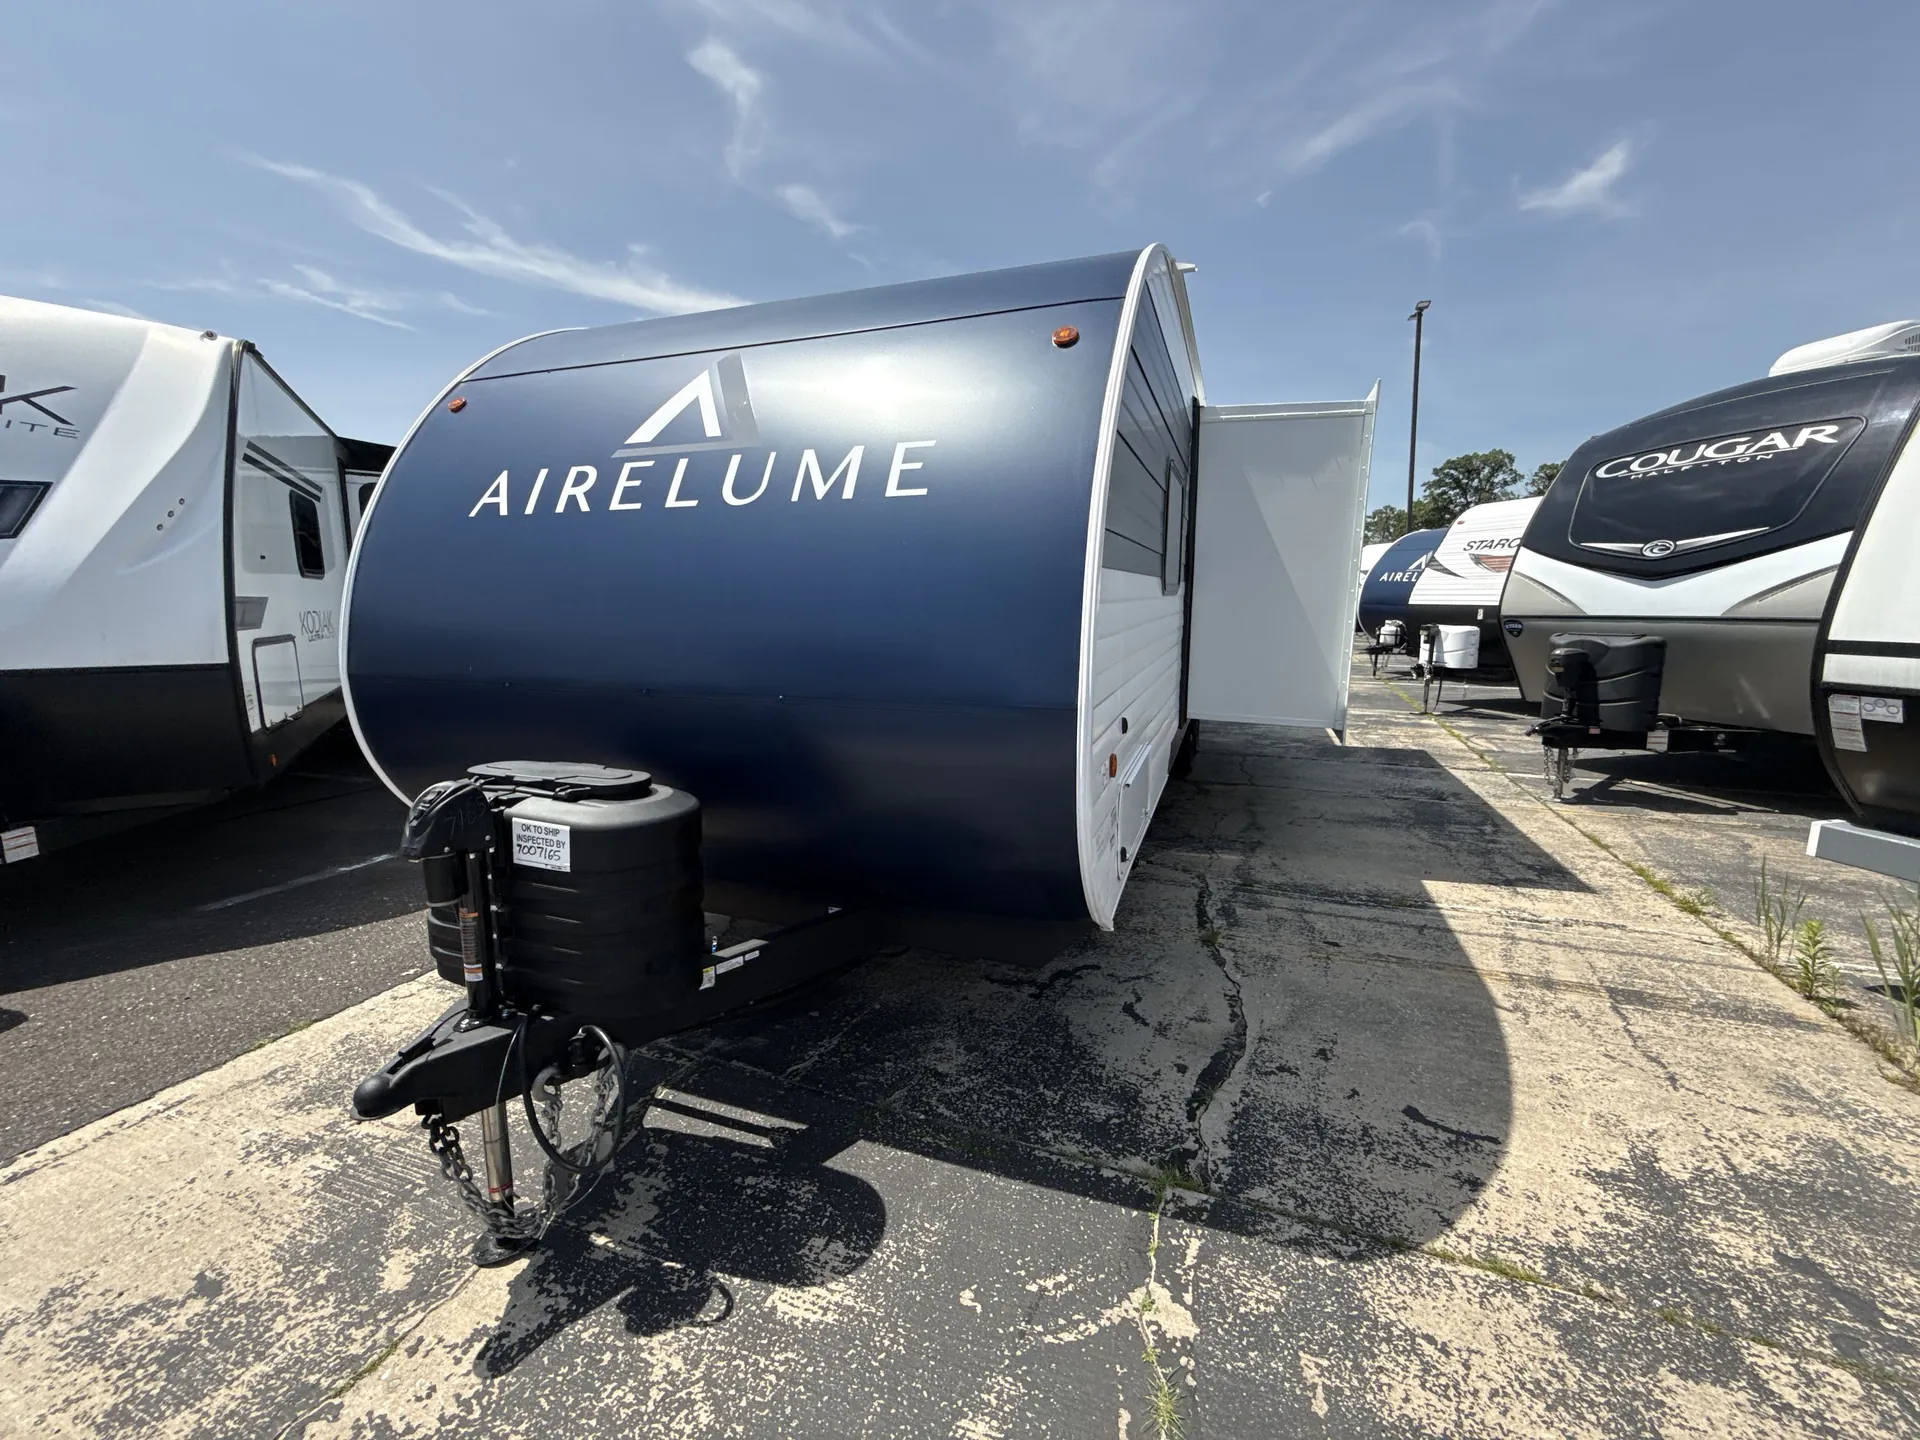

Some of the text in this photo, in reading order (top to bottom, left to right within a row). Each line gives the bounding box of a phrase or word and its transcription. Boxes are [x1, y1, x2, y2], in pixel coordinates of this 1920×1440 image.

[1595, 425, 1839, 479] COUGAR
[468, 439, 937, 517] AIRELUME
[1379, 571, 1418, 582] AIREL
[299, 610, 334, 635] KODIAK
[521, 823, 560, 837] OK TO SHIP
[516, 834, 566, 849] INSPECTED BY
[516, 843, 561, 861] 7007165
